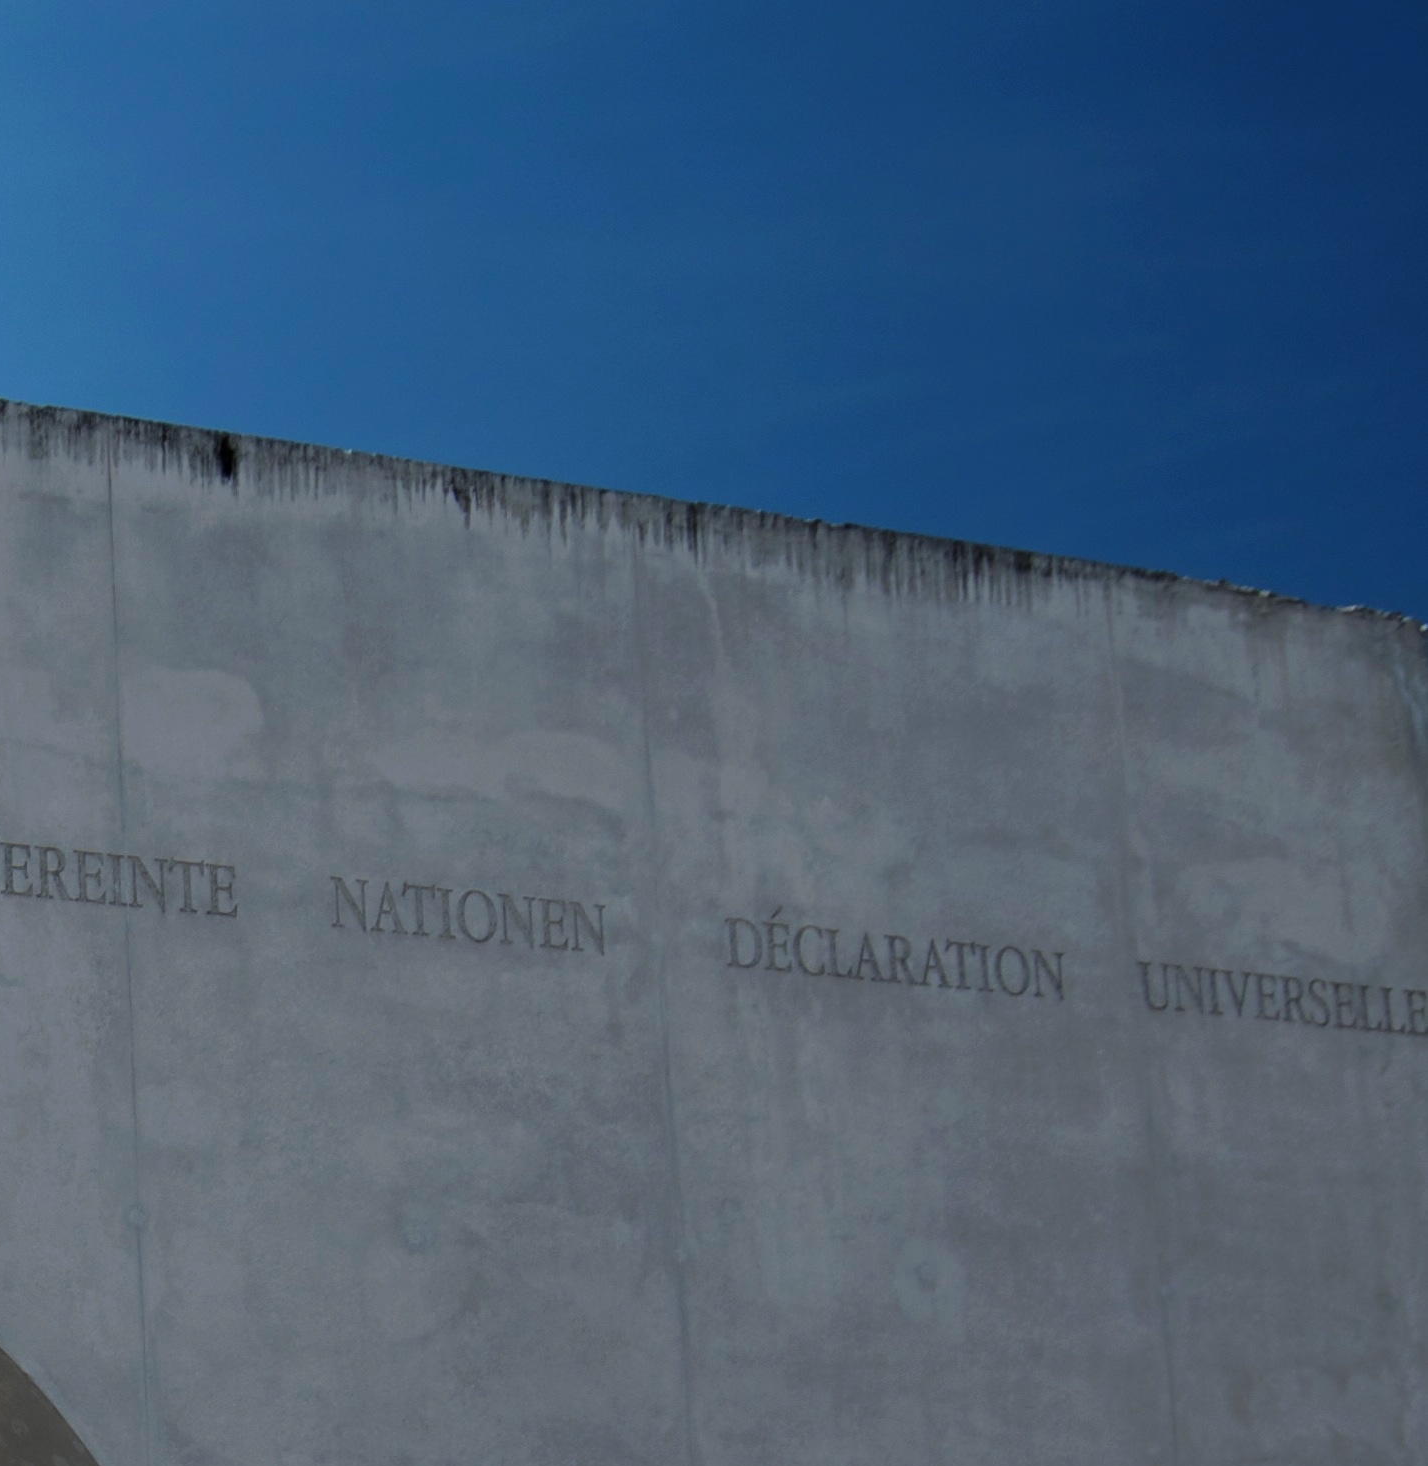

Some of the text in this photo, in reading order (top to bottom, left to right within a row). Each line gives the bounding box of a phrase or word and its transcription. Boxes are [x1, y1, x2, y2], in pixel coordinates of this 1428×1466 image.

[329, 875, 608, 956] NATIONEN
[724, 906, 1066, 1002] DÉCLARATION
[1137, 960, 1428, 1038] UNIVERSELLE
